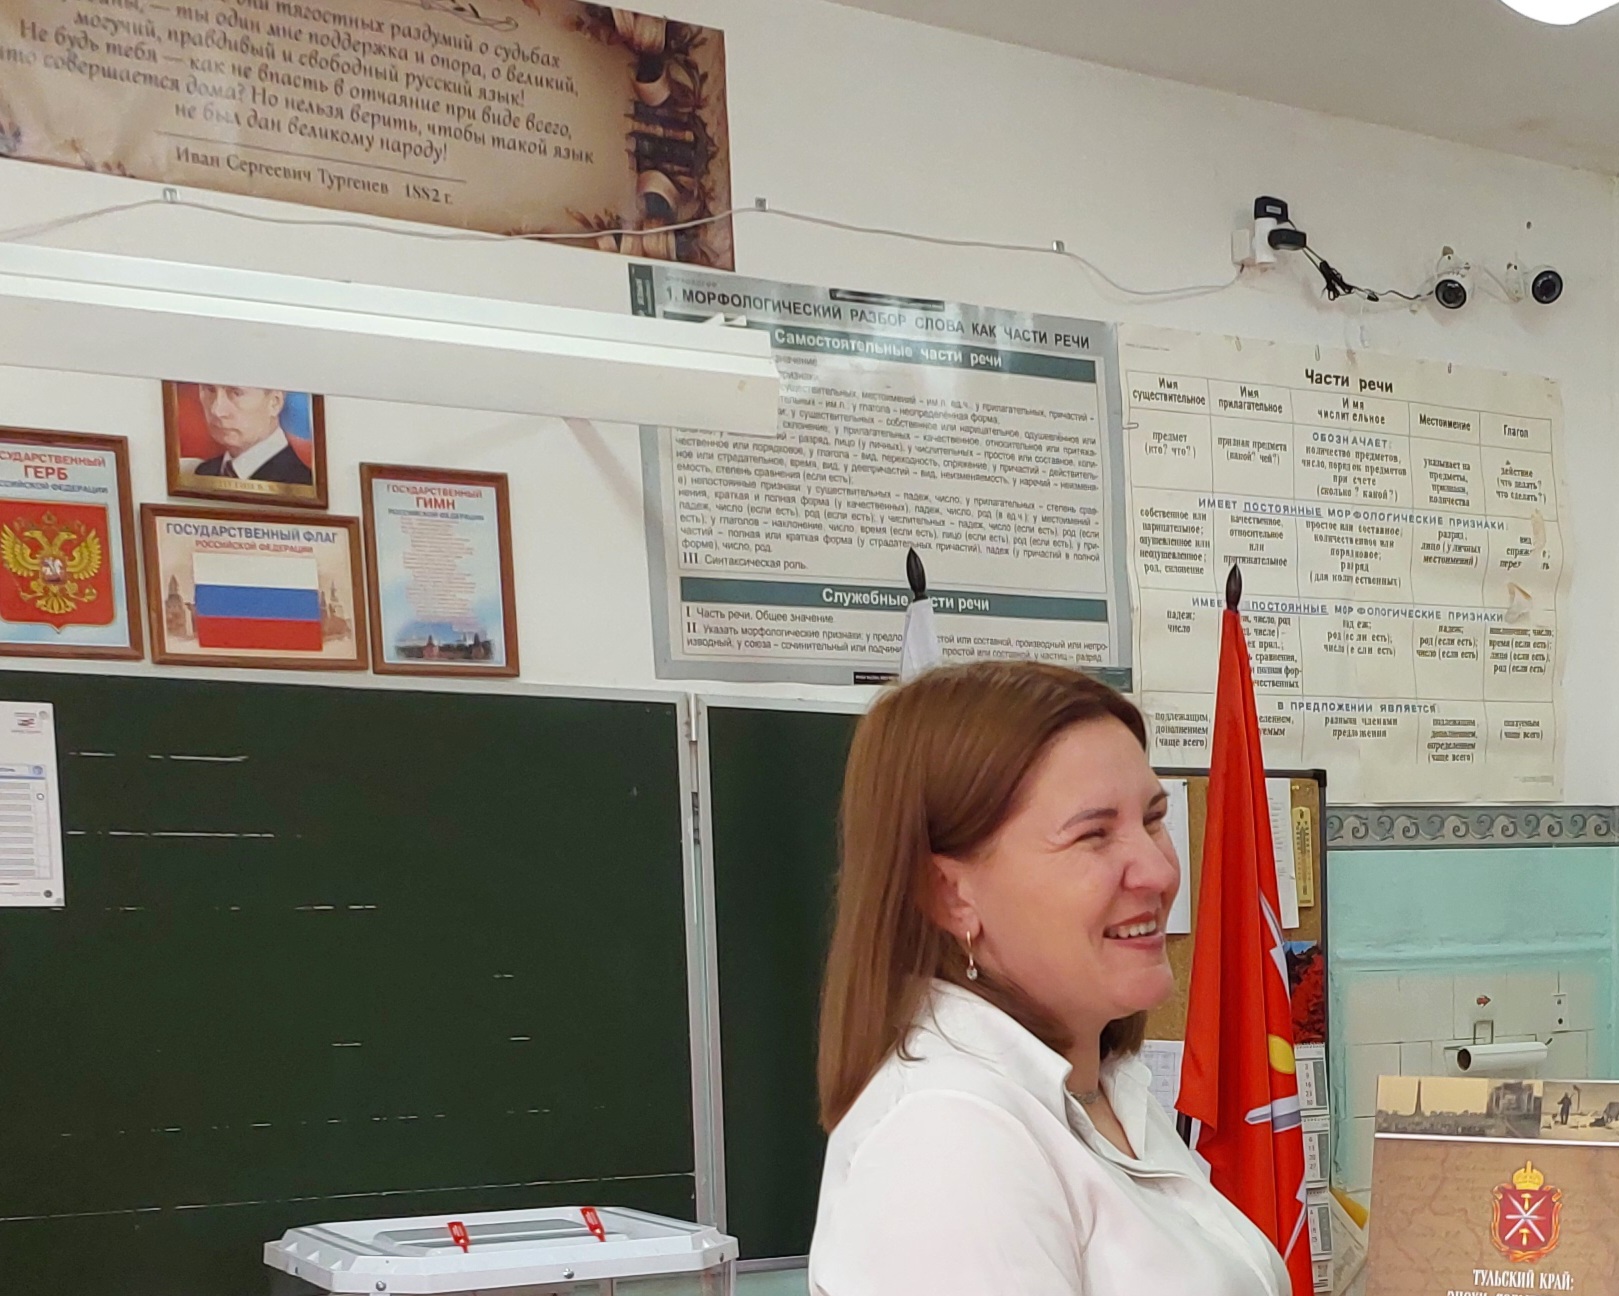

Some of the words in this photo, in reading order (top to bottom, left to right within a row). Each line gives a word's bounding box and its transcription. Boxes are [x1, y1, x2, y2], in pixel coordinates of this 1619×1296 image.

[73, 10, 161, 43] могучий,
[167, 26, 275, 59] правдивый
[282, 51, 292, 64] и
[299, 53, 398, 82] свободный
[406, 70, 472, 95] русский
[479, 86, 525, 107] язык!
[44, 51, 180, 92] совершается
[186, 75, 245, 101] дома?
[251, 87, 279, 107] Но
[285, 96, 344, 119] нельзя
[350, 104, 422, 136] верить,
[426, 122, 485, 145] чтобы
[491, 136, 548, 156] такой
[553, 147, 594, 164] язык
[175, 103, 197, 119] не
[202, 104, 242, 126] был
[246, 112, 282, 132] дан
[287, 114, 375, 151] великому
[379, 137, 448, 164] народу!
[175, 146, 220, 168] Иван
[226, 154, 311, 183] Сергеевич
[317, 167, 390, 195] Тургенев
[682, 289, 842, 320] МОРФОЛОГИЧЕСКИЙ
[850, 308, 907, 327] РАЗБОР
[915, 317, 964, 334] СЛОВА
[972, 322, 996, 338] КАК
[1004, 326, 1047, 344] ЧАСТИ
[1055, 333, 1089, 349] РЕЧИ
[774, 329, 912, 357] Самостоятельные
[921, 349, 962, 362] части
[970, 354, 1002, 368] речи
[1158, 377, 1178, 389] Имя
[1305, 369, 1349, 387] Части
[1359, 377, 1393, 393] речи
[1133, 389, 1206, 406] существительное
[1240, 386, 1259, 398] Имя
[1218, 398, 1283, 414] прилагательное
[1419, 413, 1471, 432] Местоимение
[1503, 425, 1529, 438] Глагол
[24, 465, 68, 481] ГЕРБ
[416, 497, 455, 510] ГИМН
[1198, 498, 1238, 509] ИМЕЕТ
[1243, 502, 1322, 517] ПОСТОЯННЫЕ
[1328, 508, 1443, 525] МОРФОЛОГИЧЕСКИЕ
[166, 523, 300, 541] ГОСУДАРСТВЕННЫЙ
[302, 530, 338, 544] ФЛАГ
[822, 588, 908, 606] Служебные
[958, 598, 989, 612] речи
[696, 607, 725, 619] Часть
[755, 612, 787, 623] Общее
[1291, 702, 1373, 712] ПРЕДЛОЖЕНИИ
[1473, 1269, 1534, 1289] ТУЛЬСКИЙ
[1539, 1271, 1574, 1291] КРАЙ:
